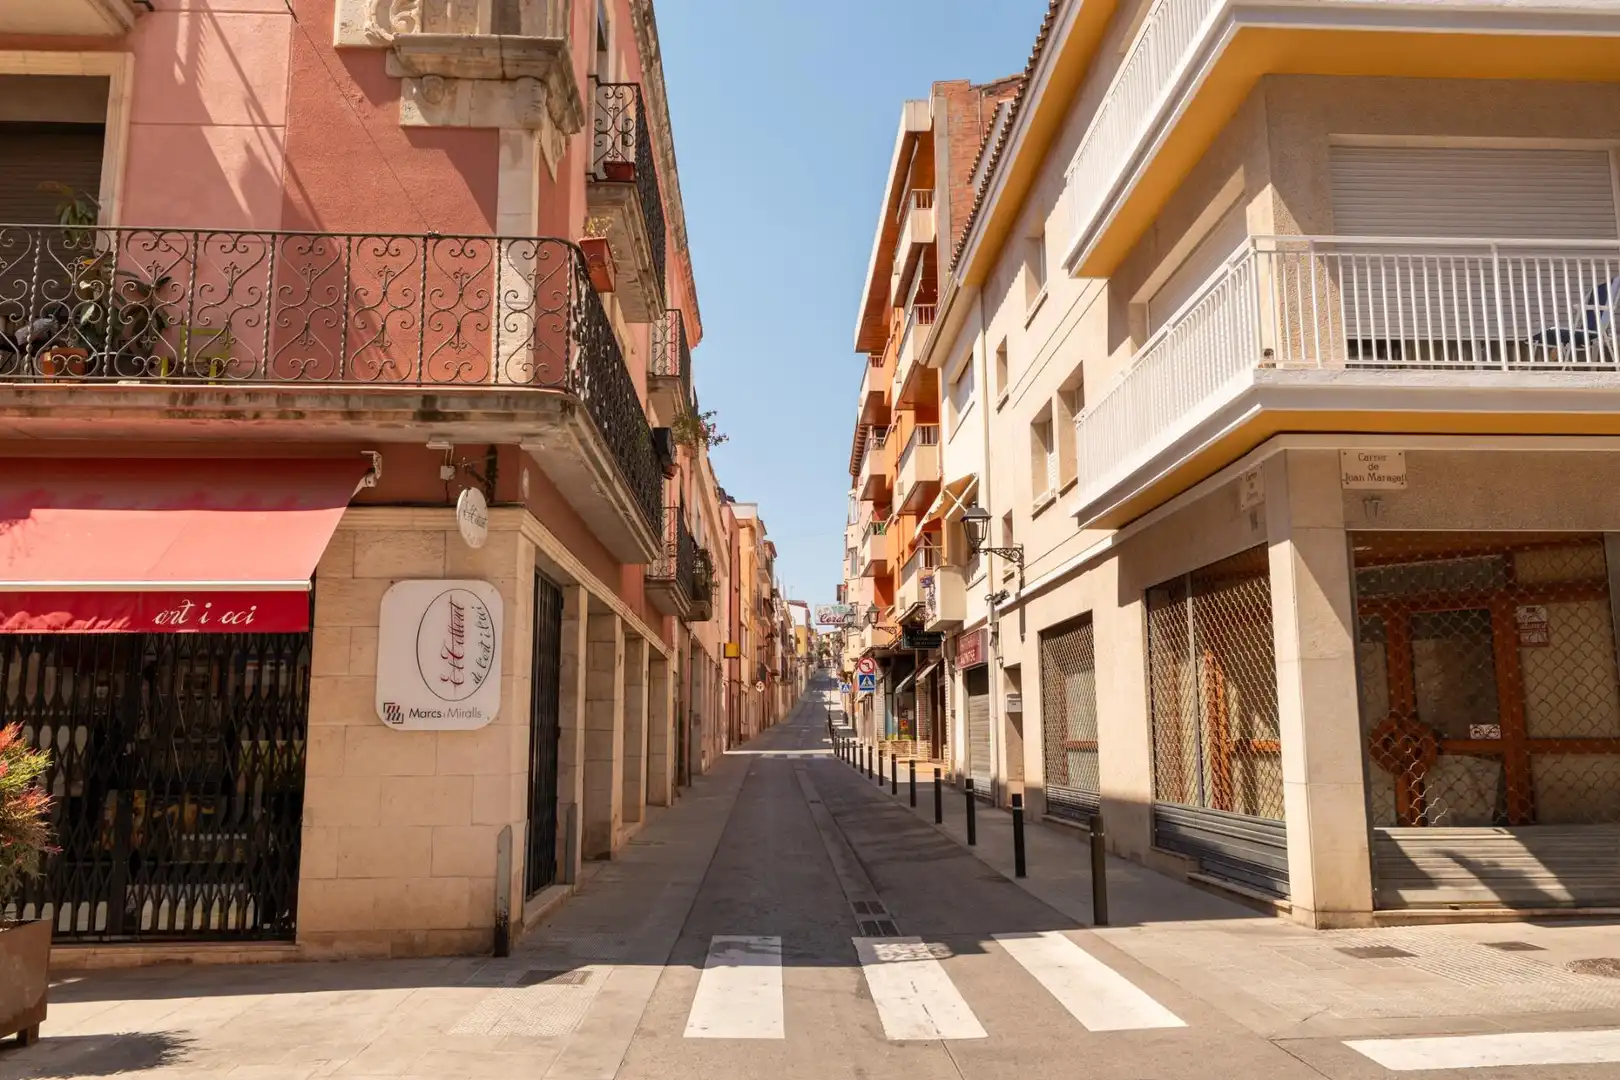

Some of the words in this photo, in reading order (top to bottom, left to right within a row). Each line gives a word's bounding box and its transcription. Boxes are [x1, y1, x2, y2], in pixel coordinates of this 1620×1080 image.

[1358, 452, 1387, 461] Carrer
[1367, 463, 1379, 471] de
[1342, 472, 1365, 482] Joan
[1368, 472, 1407, 483] Maragall
[152, 599, 196, 625] art
[199, 602, 213, 625] i
[217, 605, 257, 625] oci
[409, 707, 442, 719] Marcs
[447, 707, 482, 719] Miralls
